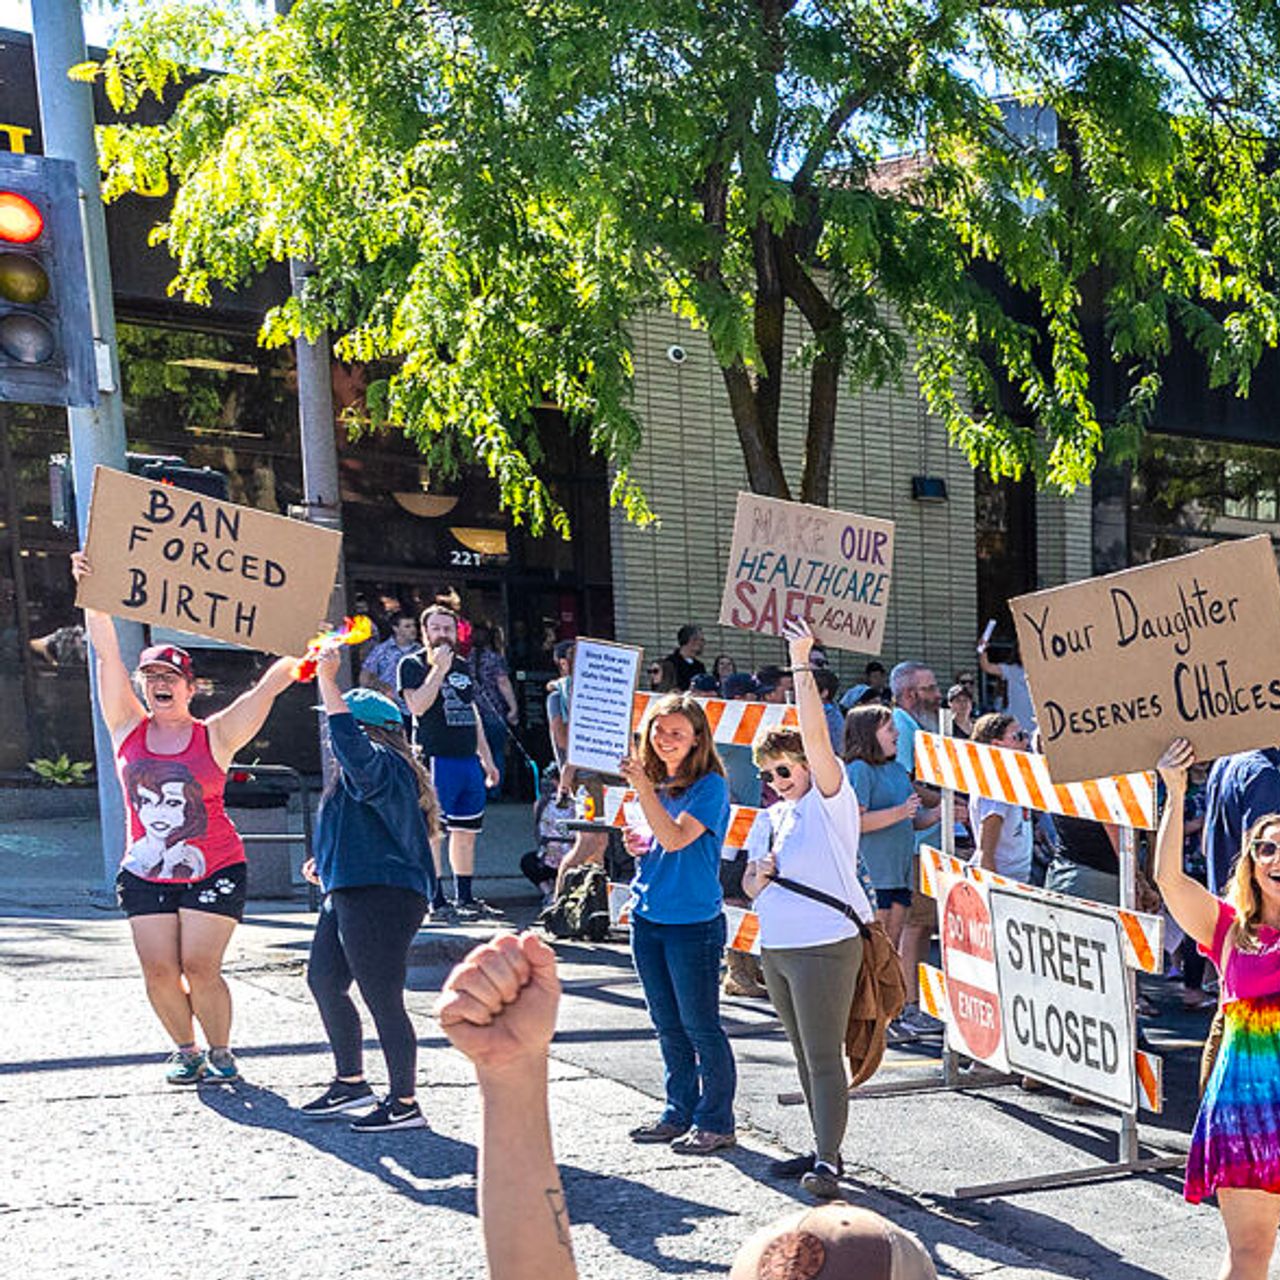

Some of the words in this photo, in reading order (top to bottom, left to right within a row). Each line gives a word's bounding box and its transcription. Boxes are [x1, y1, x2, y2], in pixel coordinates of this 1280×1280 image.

[143, 488, 241, 541] BAN
[751, 506, 829, 554] MAKE
[840, 525, 888, 566] OUR
[128, 525, 286, 588] FORCED
[450, 551, 480, 566] 221
[735, 547, 890, 607] HEALTHCARE
[122, 568, 256, 637] BIRTH
[731, 580, 825, 642] SAFE
[821, 607, 877, 640] AGAIN
[1023, 606, 1094, 661] Your
[1110, 578, 1239, 655] Daughter
[1044, 694, 1163, 742] DESERVES
[948, 912, 963, 941] DO
[968, 917, 992, 950] NOT
[1006, 918, 1107, 994] STREET
[958, 991, 996, 1030] ENTER
[1013, 995, 1119, 1074] CLOSED
